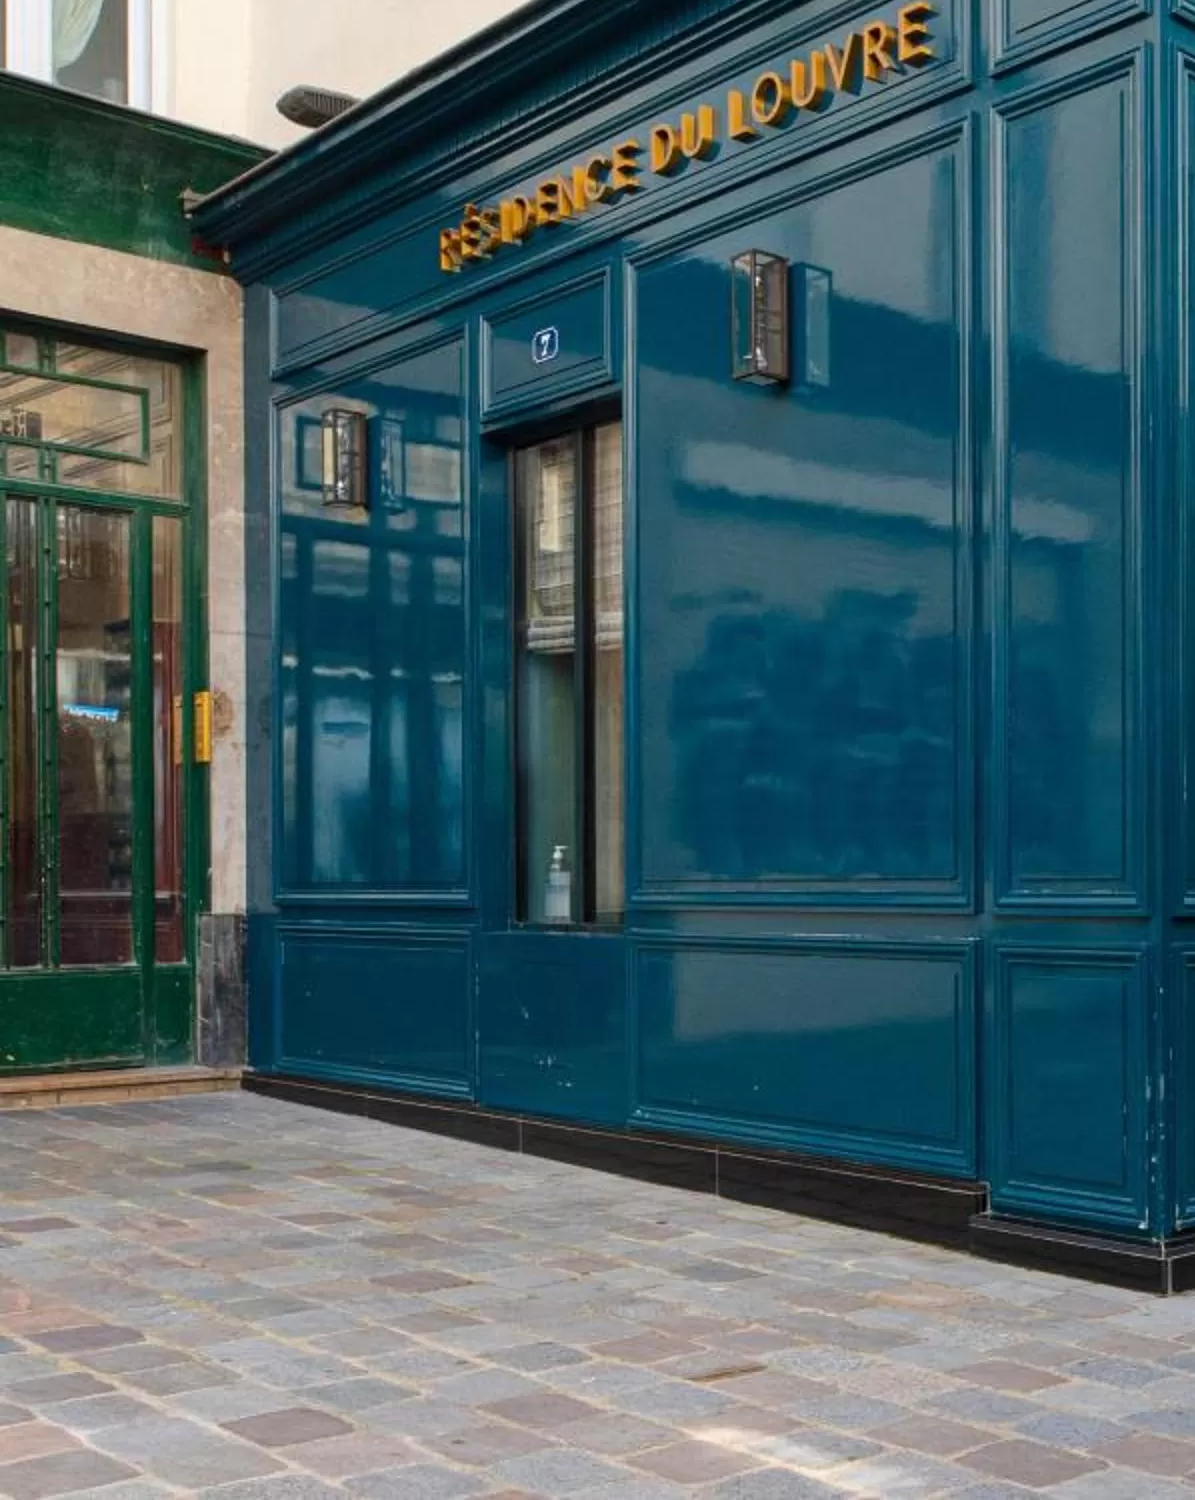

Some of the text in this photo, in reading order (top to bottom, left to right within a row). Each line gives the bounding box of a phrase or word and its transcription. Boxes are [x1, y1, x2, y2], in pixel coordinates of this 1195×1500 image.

[650, 104, 716, 174] DU
[727, 0, 934, 141] LOUVRE
[541, 333, 551, 357] 7
